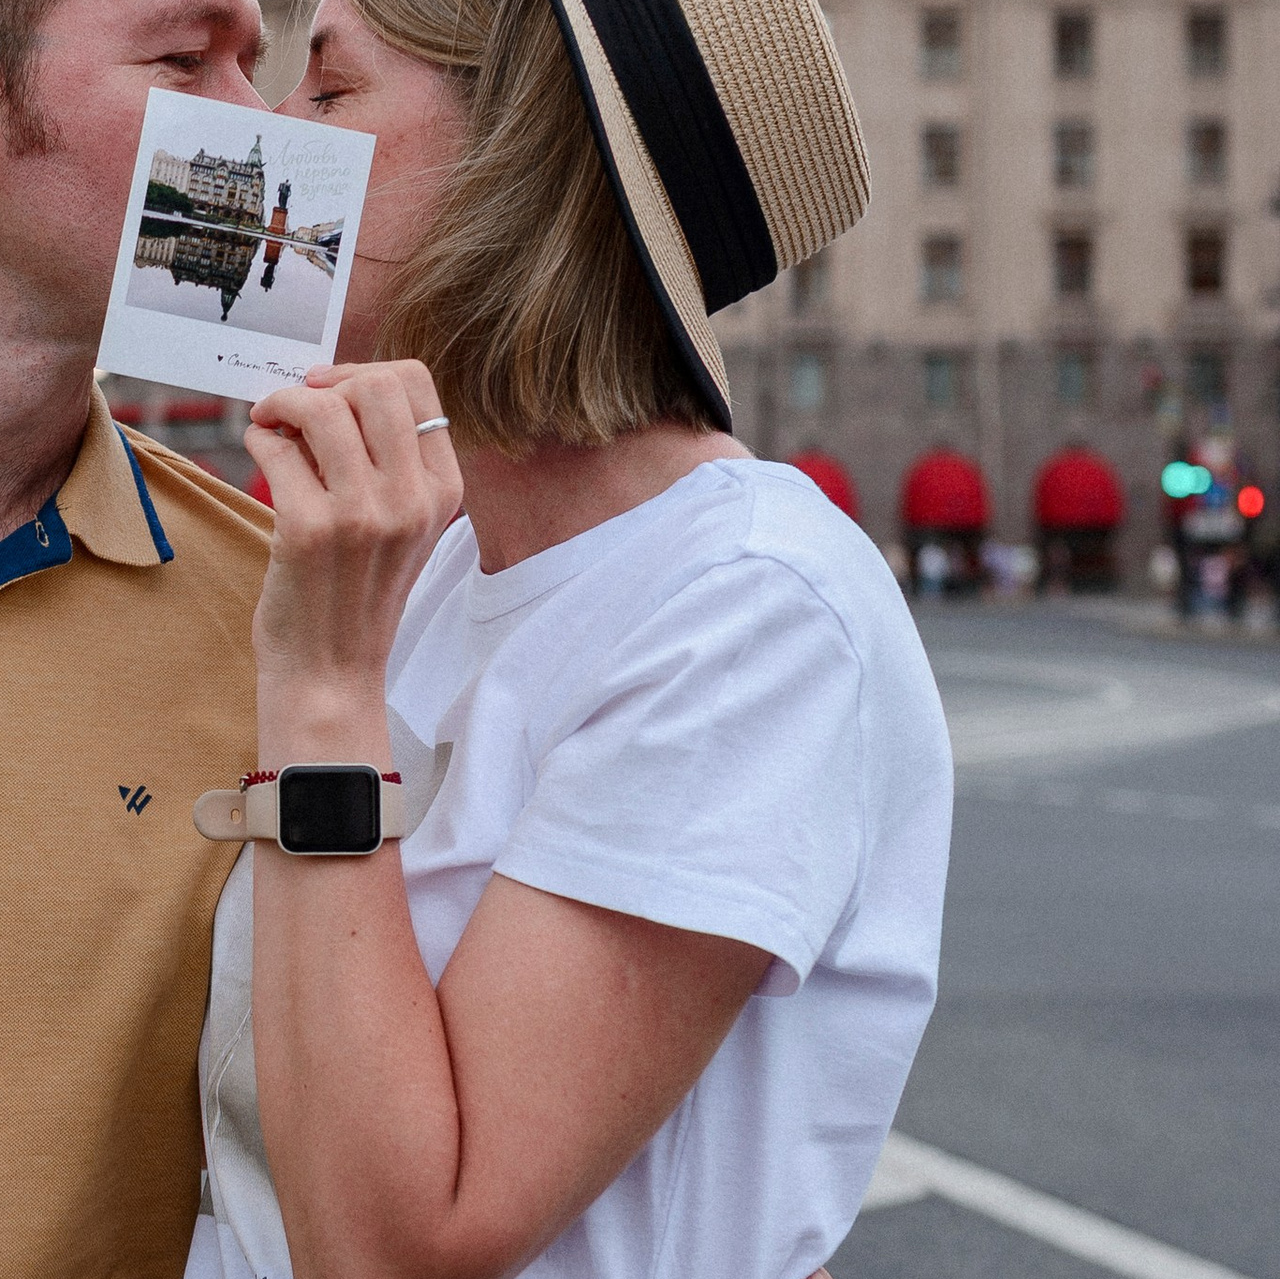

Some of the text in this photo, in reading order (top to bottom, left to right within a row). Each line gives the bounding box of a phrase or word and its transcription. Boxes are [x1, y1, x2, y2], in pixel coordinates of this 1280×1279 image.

[268, 139, 338, 167] Любовь
[294, 167, 352, 183] первого
[227, 353, 307, 383] Санкт-Петербур
